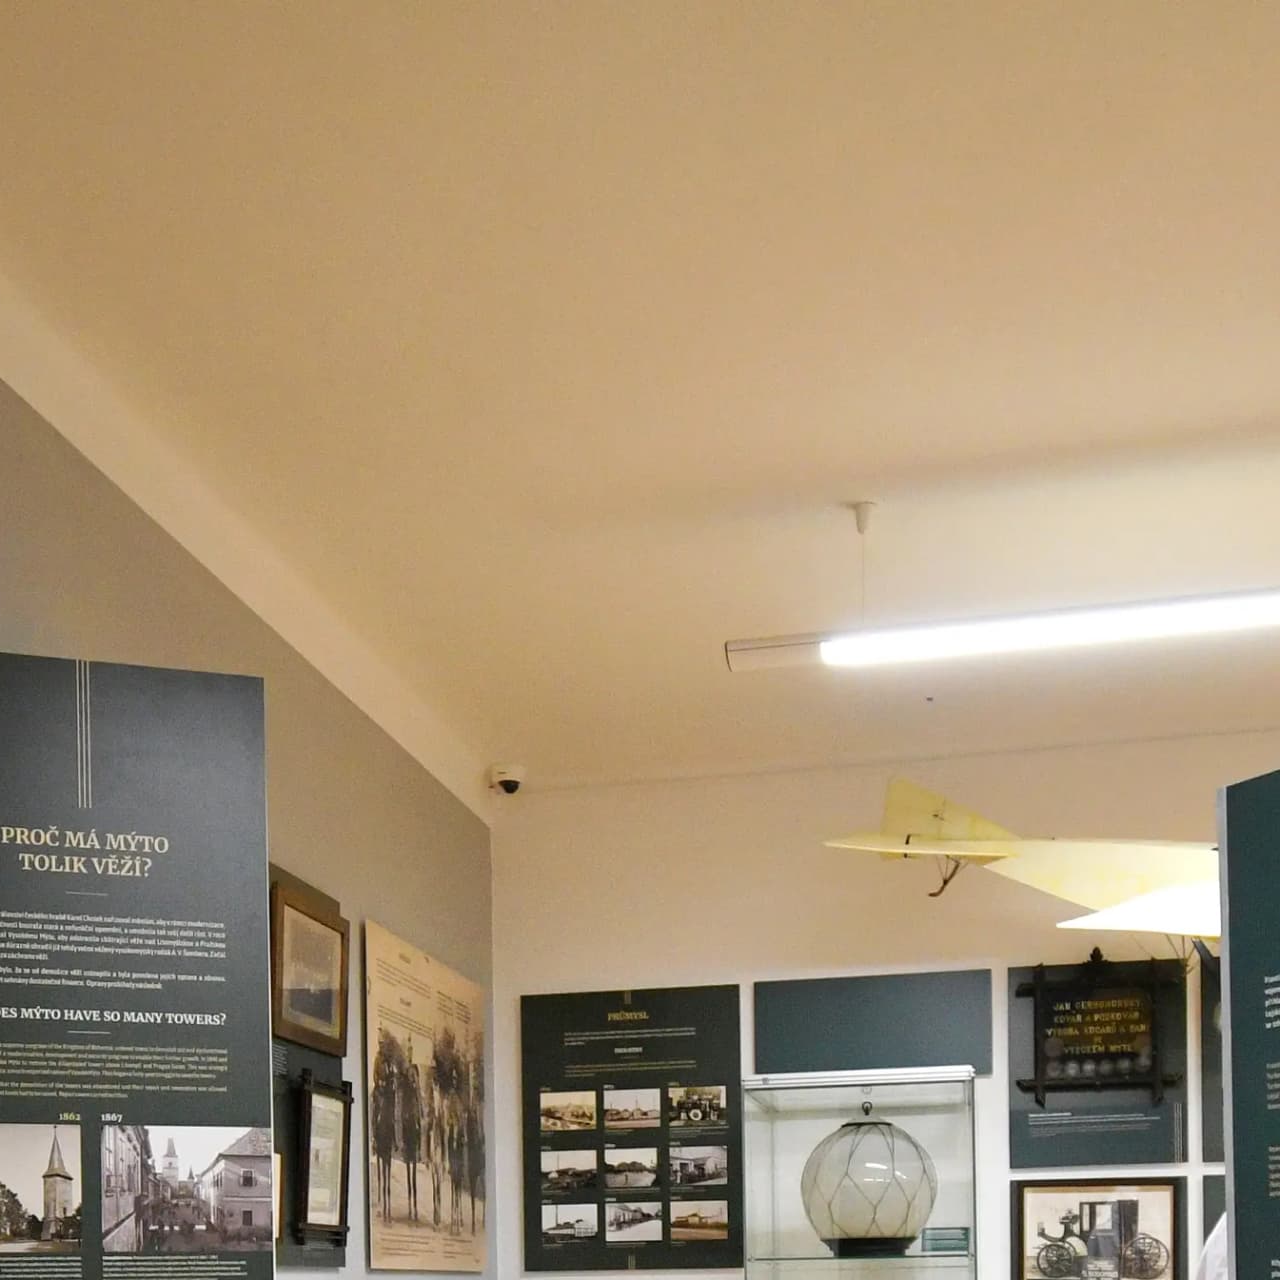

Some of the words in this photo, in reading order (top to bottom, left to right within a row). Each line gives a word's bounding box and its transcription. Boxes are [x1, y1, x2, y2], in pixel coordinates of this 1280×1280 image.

[2, 826, 59, 846] PROČ
[65, 829, 100, 849] MÁ
[106, 831, 169, 853] MÝTO
[19, 854, 87, 873] TOLIK
[91, 855, 152, 877] VĚŽÍ?
[21, 1006, 61, 1019] MÝTO
[64, 1010, 101, 1021] HAVE
[104, 1011, 120, 1021] SO
[123, 1012, 163, 1023] MANY
[165, 1013, 226, 1025] TOWERS?
[102, 1113, 123, 1123] 1867
